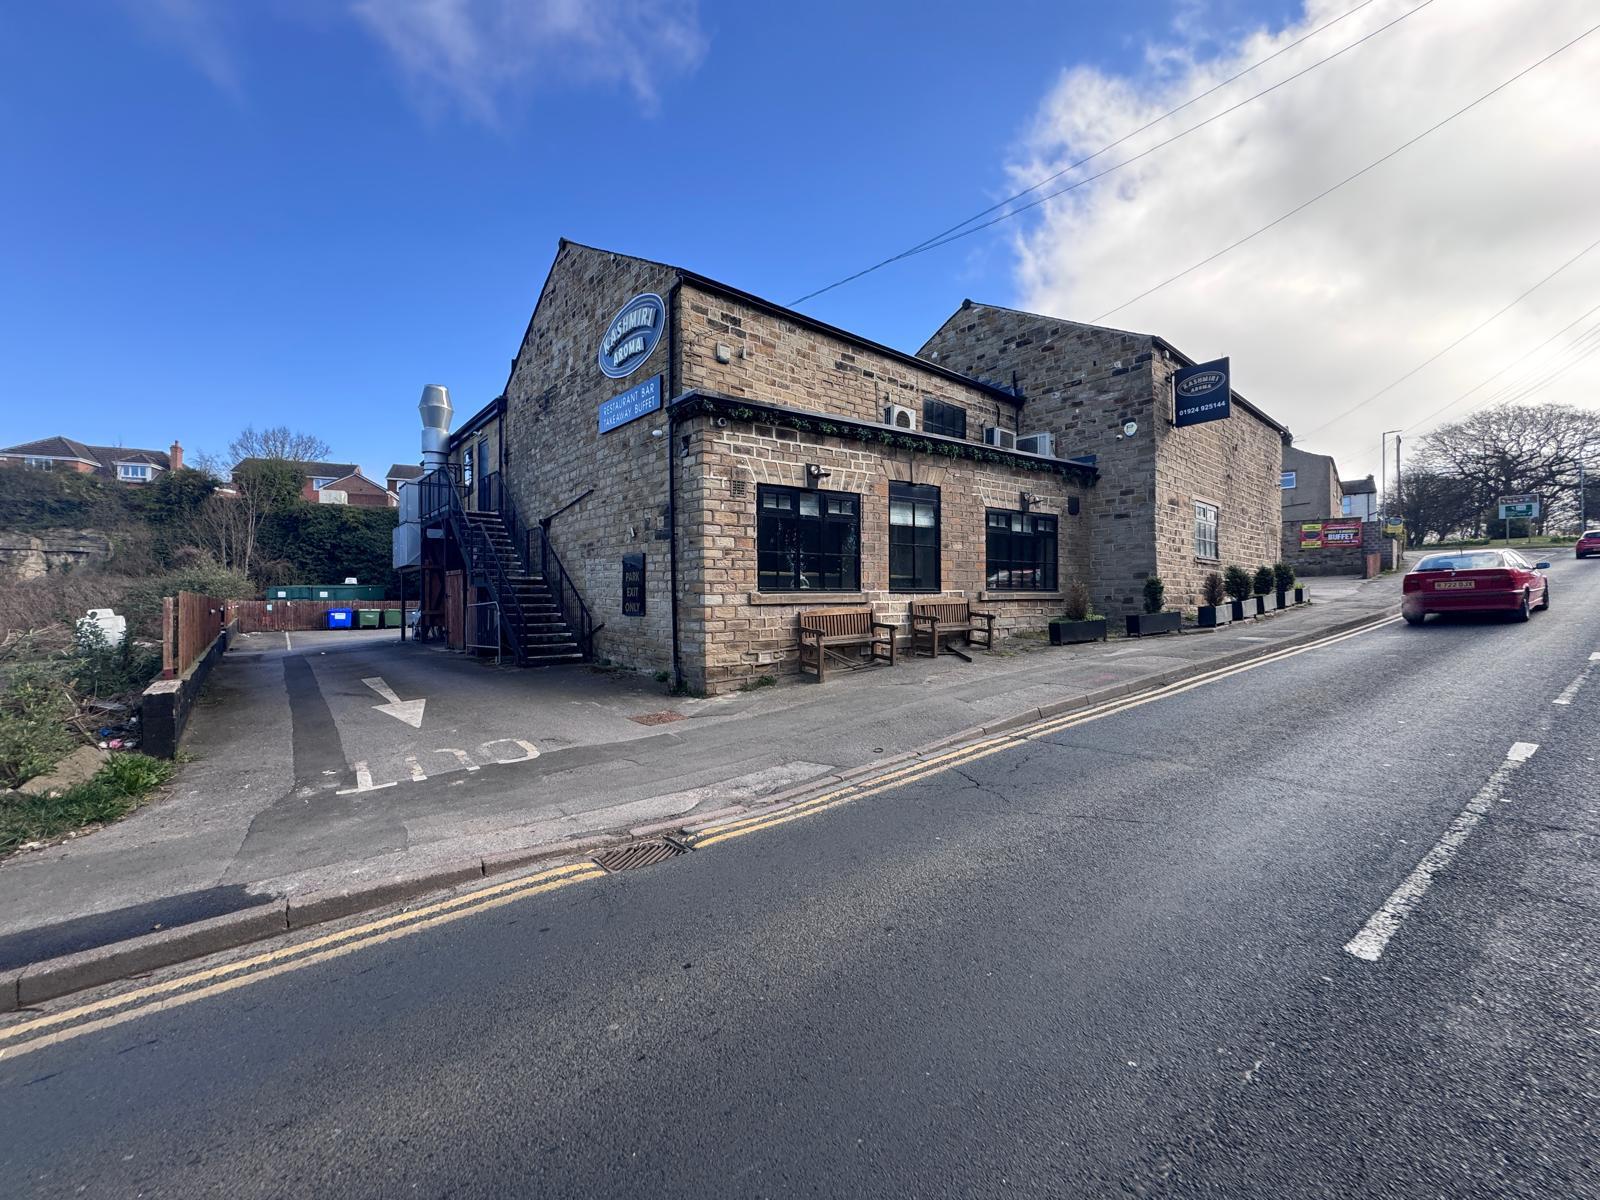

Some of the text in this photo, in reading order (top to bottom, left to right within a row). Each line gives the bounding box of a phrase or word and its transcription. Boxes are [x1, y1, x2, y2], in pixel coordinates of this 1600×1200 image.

[603, 307, 657, 355] KASHMIRI
[613, 336, 645, 367] AROMA
[1182, 375, 1219, 389] KASHMIRI
[603, 383, 655, 416] RESTAURANT BAR
[603, 396, 655, 426] TAKEAWAY BUFFET
[1179, 400, 1226, 416] 01924 925144
[625, 572, 640, 582] PARK
[626, 587, 639, 597] EXIT
[625, 602, 640, 612] ONLY
